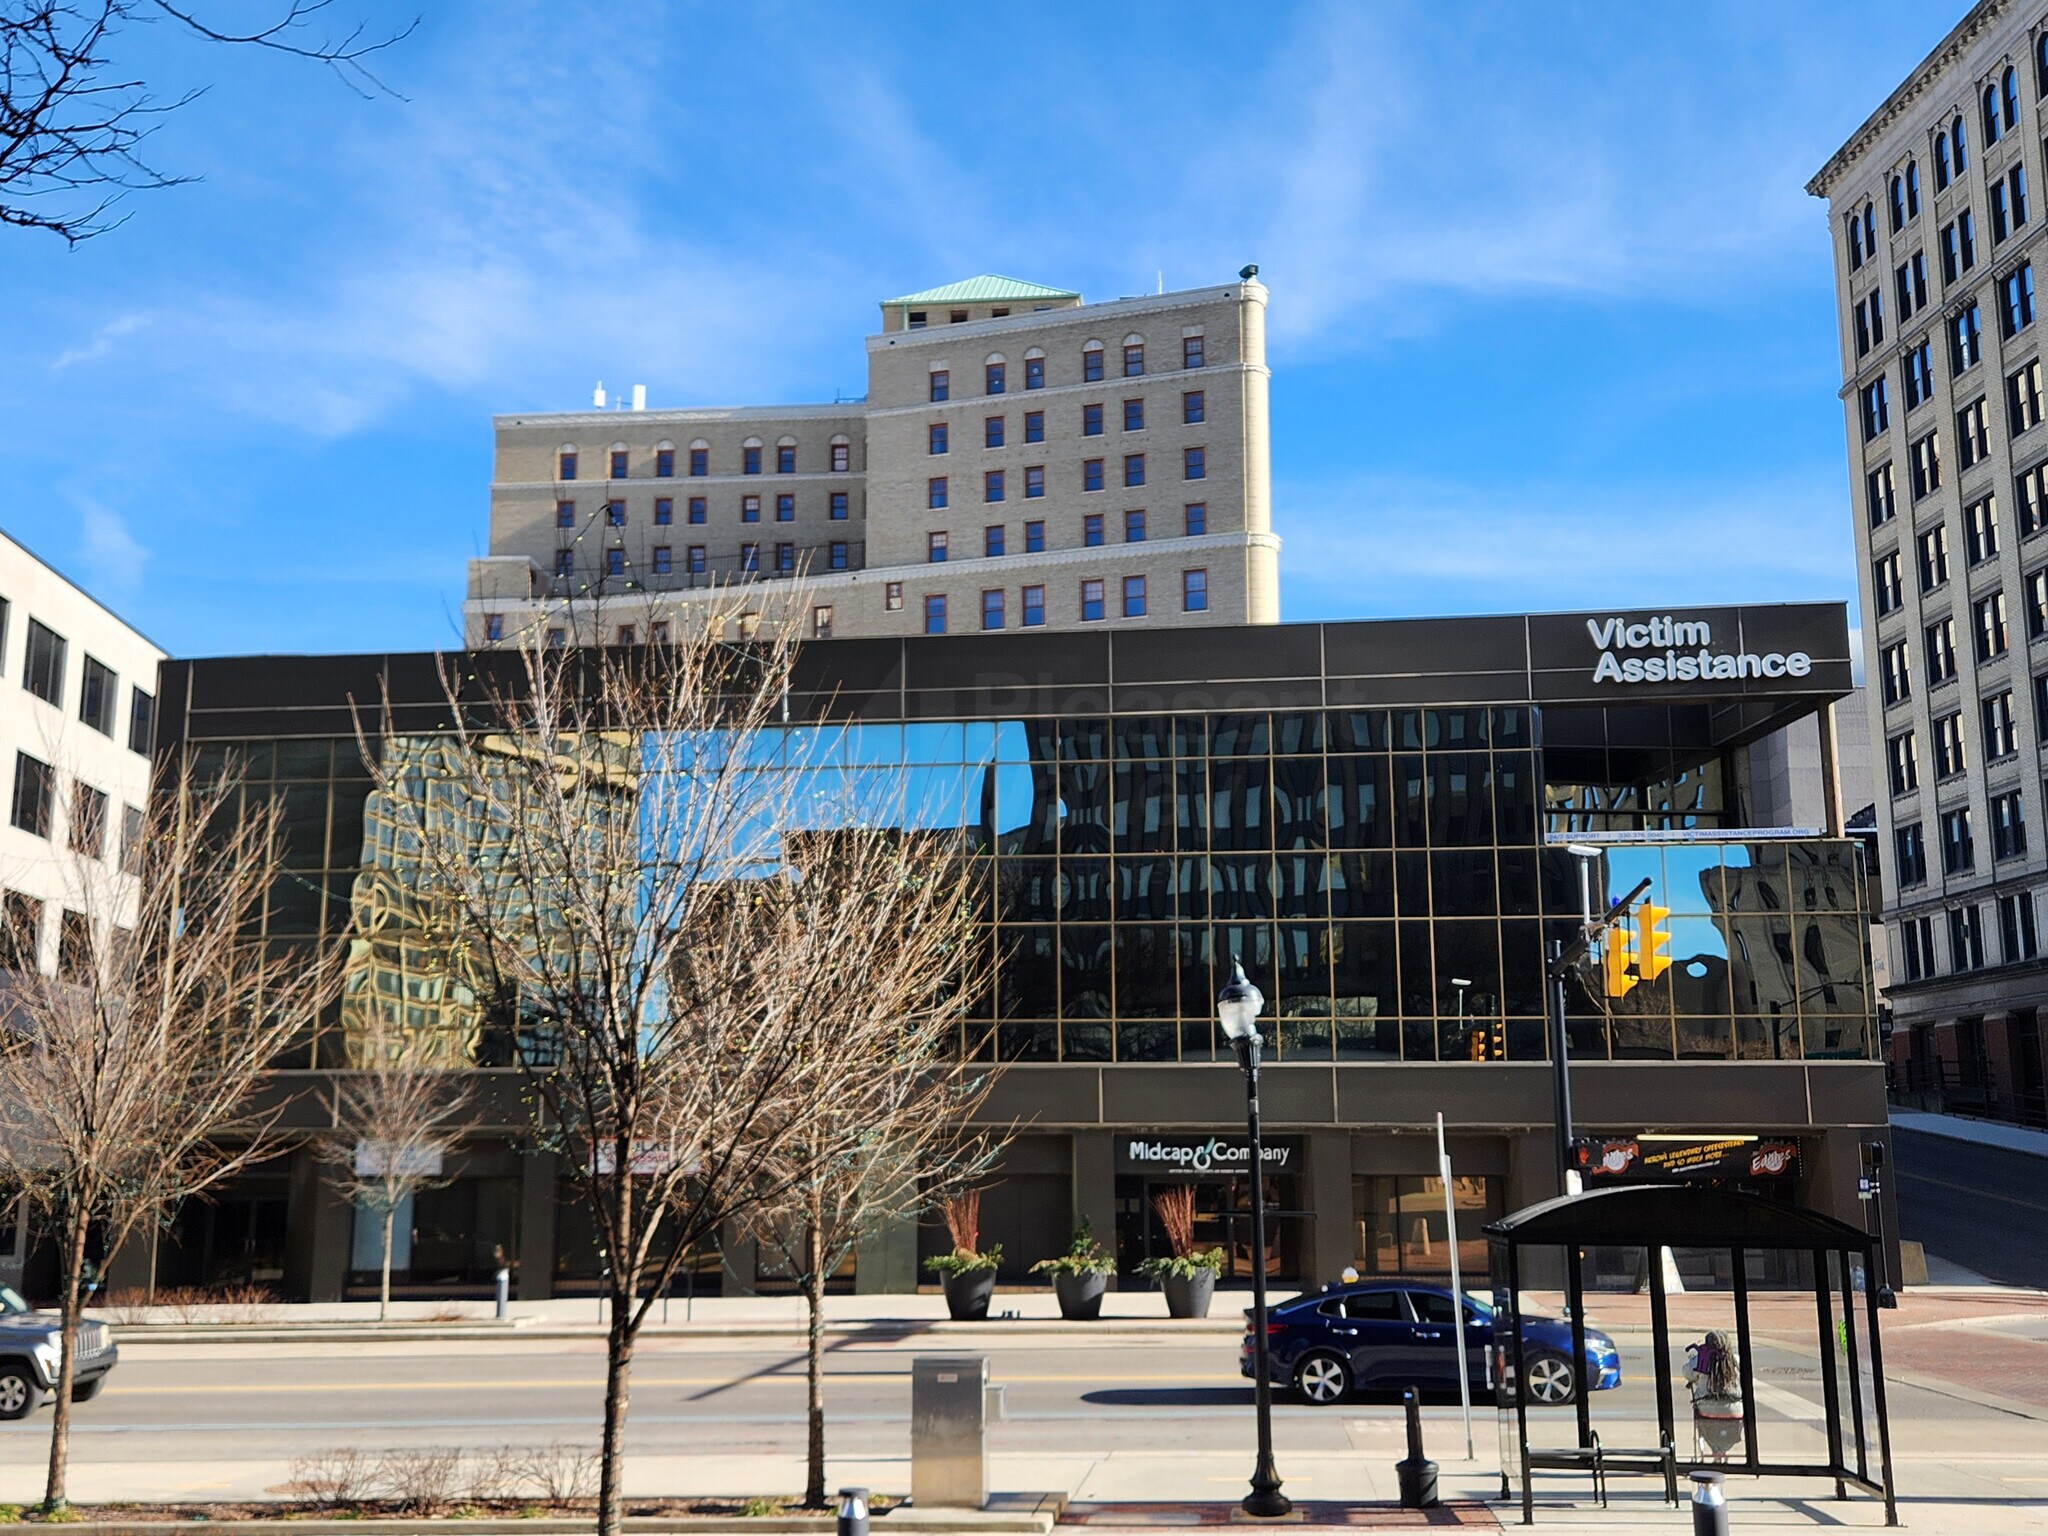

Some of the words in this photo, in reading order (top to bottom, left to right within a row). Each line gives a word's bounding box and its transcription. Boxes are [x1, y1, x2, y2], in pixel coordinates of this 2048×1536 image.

[1587, 615, 1710, 650] Victim
[1593, 649, 1811, 684] Assistance
[1129, 1141, 1193, 1166] Midcap
[1211, 1142, 1290, 1166] Comany
